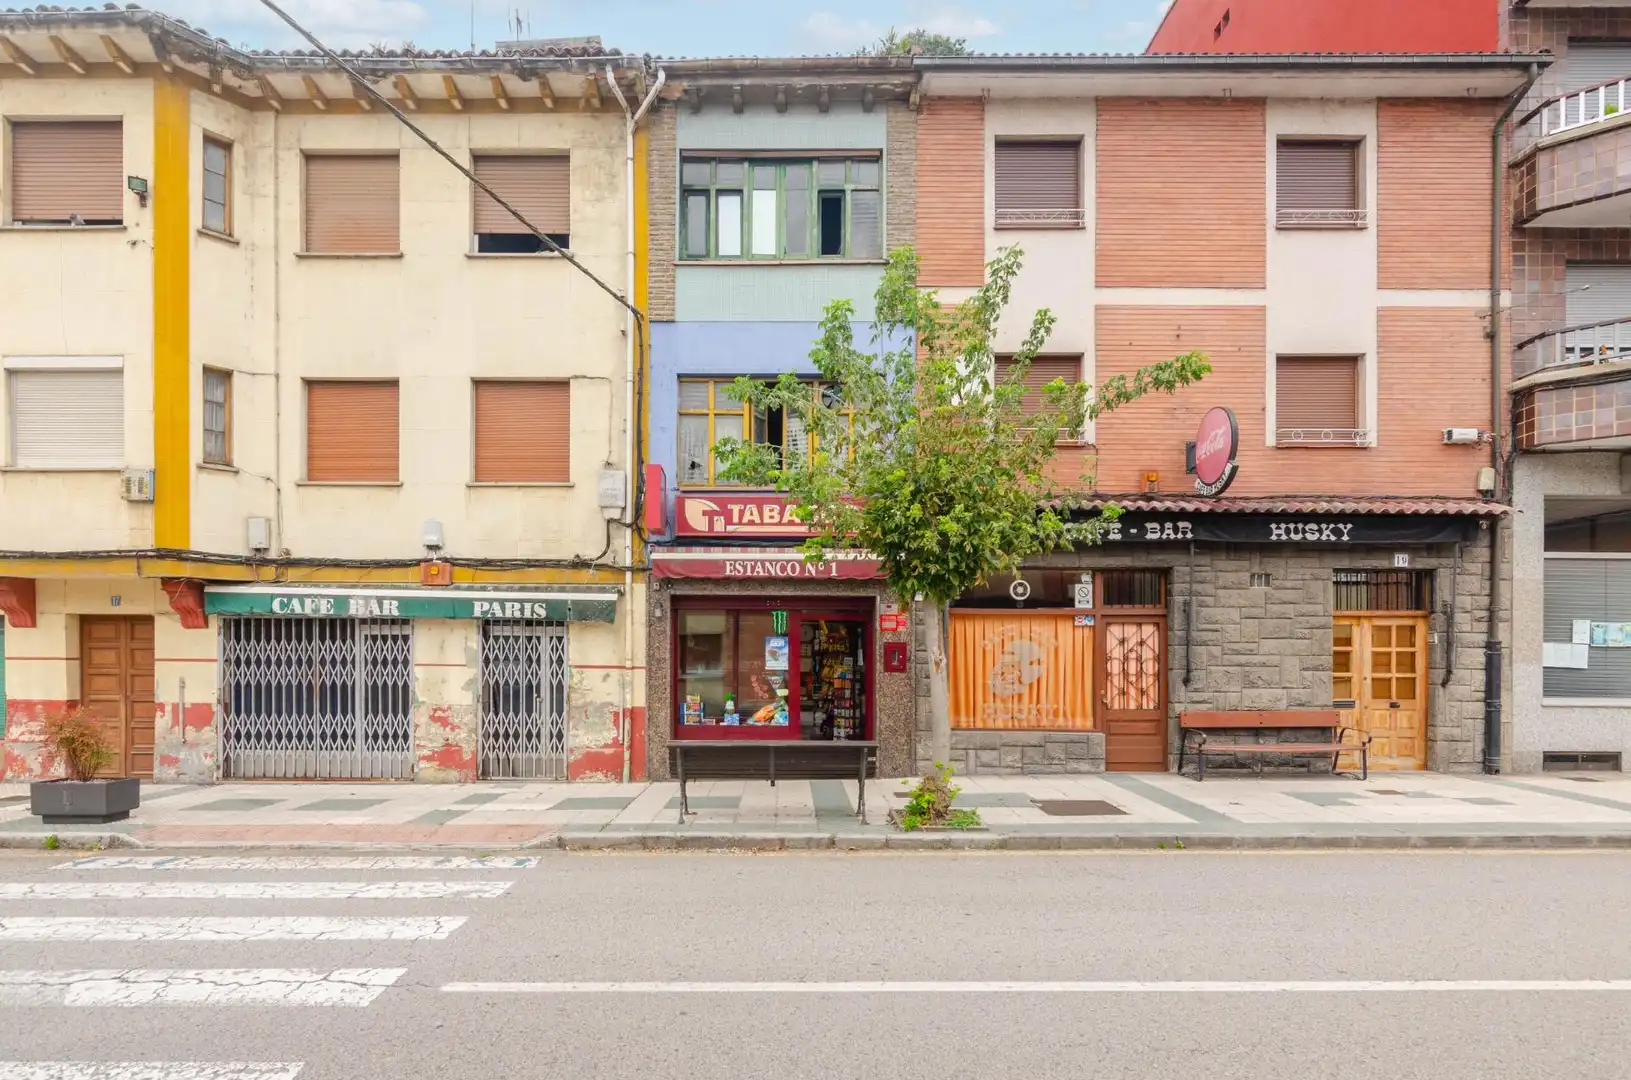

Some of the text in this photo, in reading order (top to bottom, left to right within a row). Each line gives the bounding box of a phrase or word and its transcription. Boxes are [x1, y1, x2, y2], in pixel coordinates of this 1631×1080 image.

[727, 504, 846, 524] TABA
[1144, 521, 1194, 540] BAR
[1269, 522, 1354, 541] HUSKY
[723, 560, 800, 577] ESTANCO
[829, 562, 838, 577] 1
[1396, 555, 1408, 566] 19
[271, 597, 400, 617] CAFE BAR
[472, 601, 547, 619] PARIS
